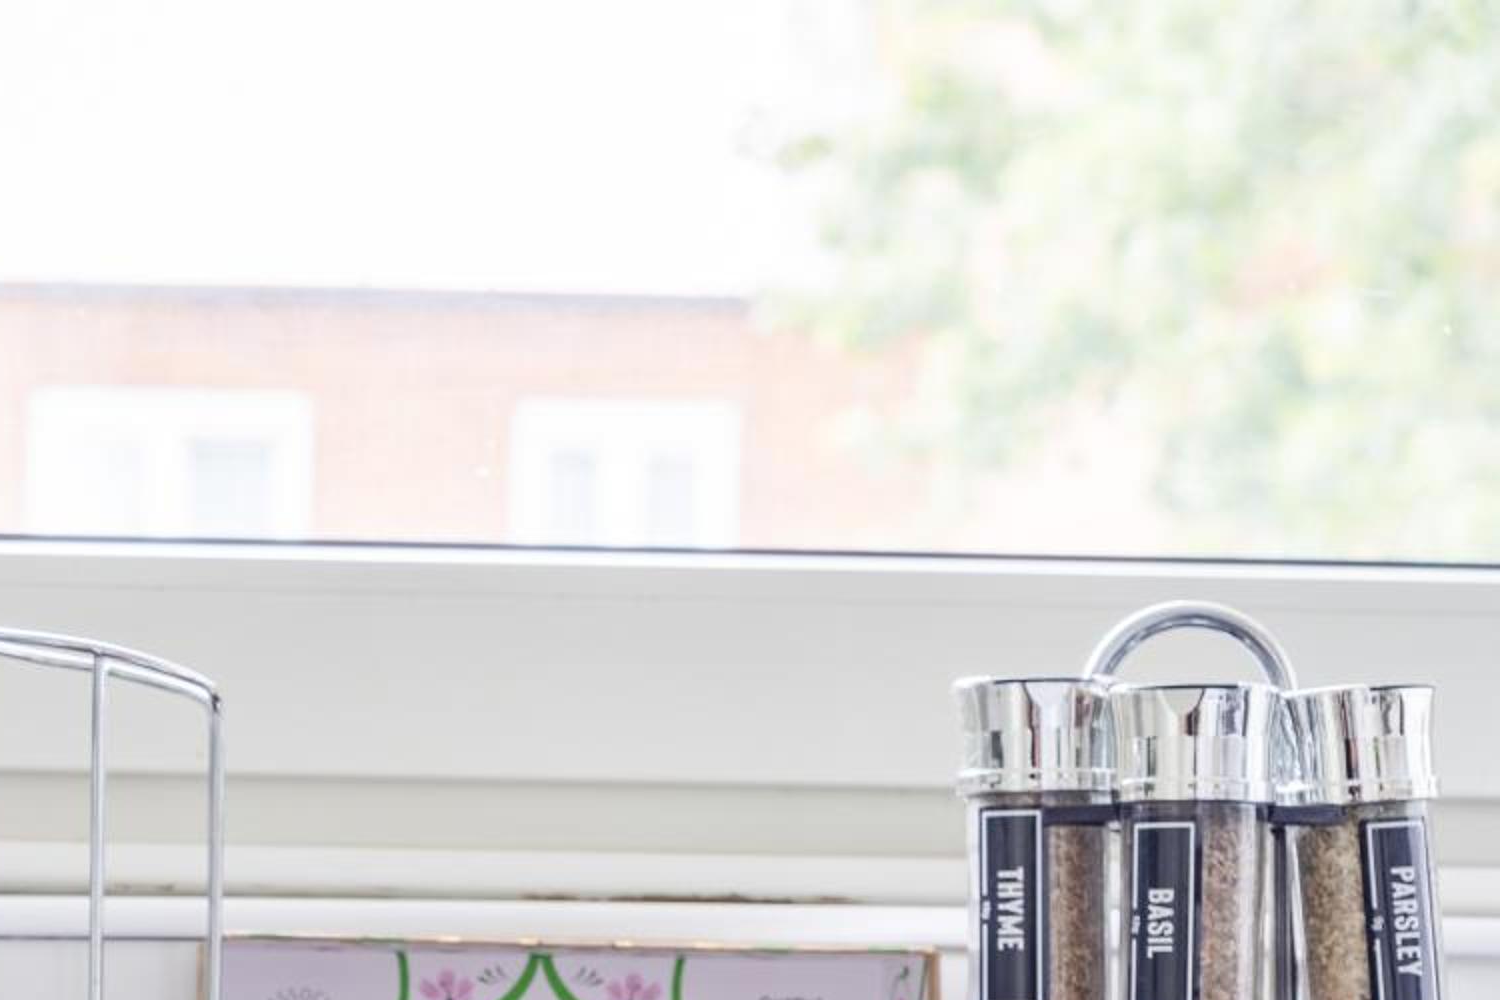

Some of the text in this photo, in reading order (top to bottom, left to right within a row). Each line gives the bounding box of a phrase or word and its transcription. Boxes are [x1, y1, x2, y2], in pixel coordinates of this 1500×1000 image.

[997, 866, 1023, 951] THYME
[1147, 888, 1174, 959] BASIL
[1390, 865, 1424, 977] PARSLEY
